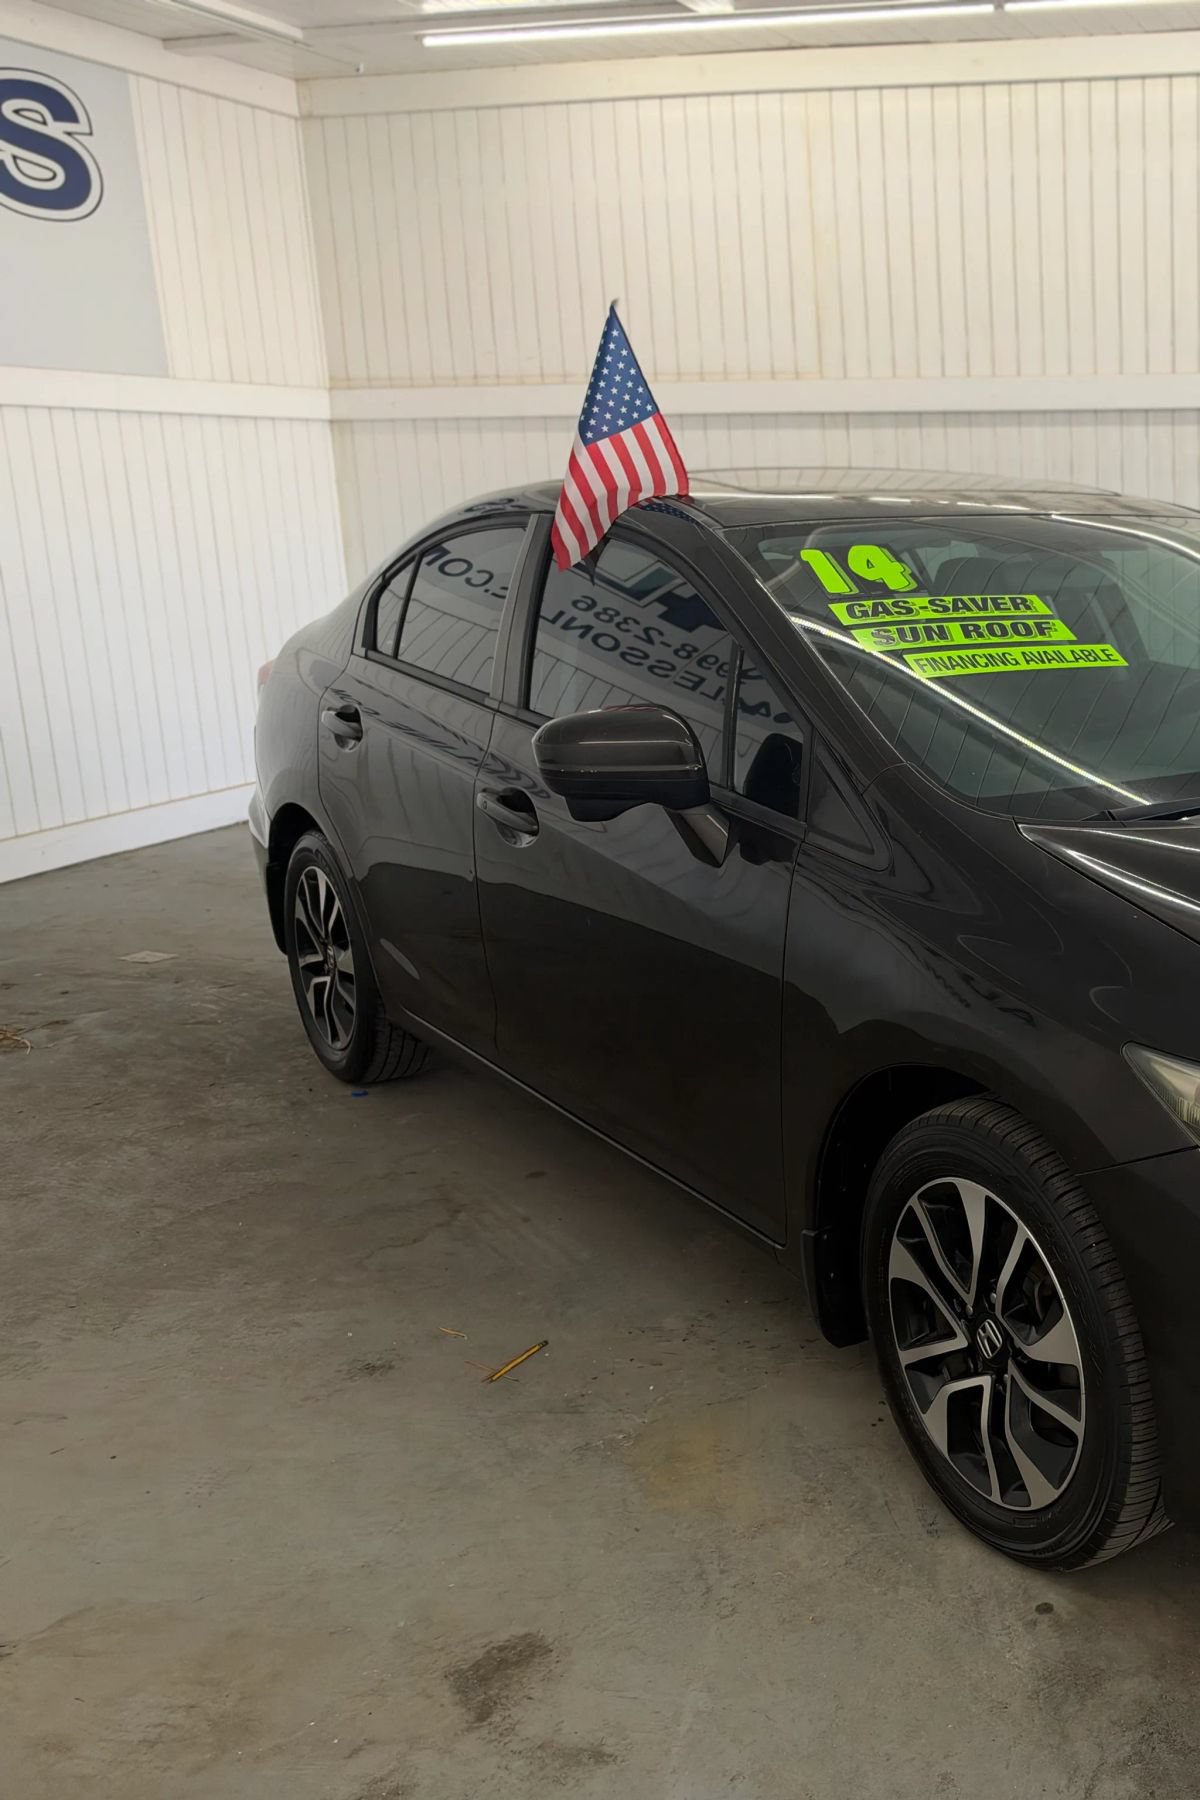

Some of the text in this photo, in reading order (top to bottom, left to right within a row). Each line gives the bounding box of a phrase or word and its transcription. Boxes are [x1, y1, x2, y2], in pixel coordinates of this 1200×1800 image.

[800, 545, 917, 594] 14
[848, 596, 1036, 620] GAS-SAVER
[871, 621, 1057, 646] SUN ROOF
[914, 648, 1119, 675] FINANCING AVAILABLE
